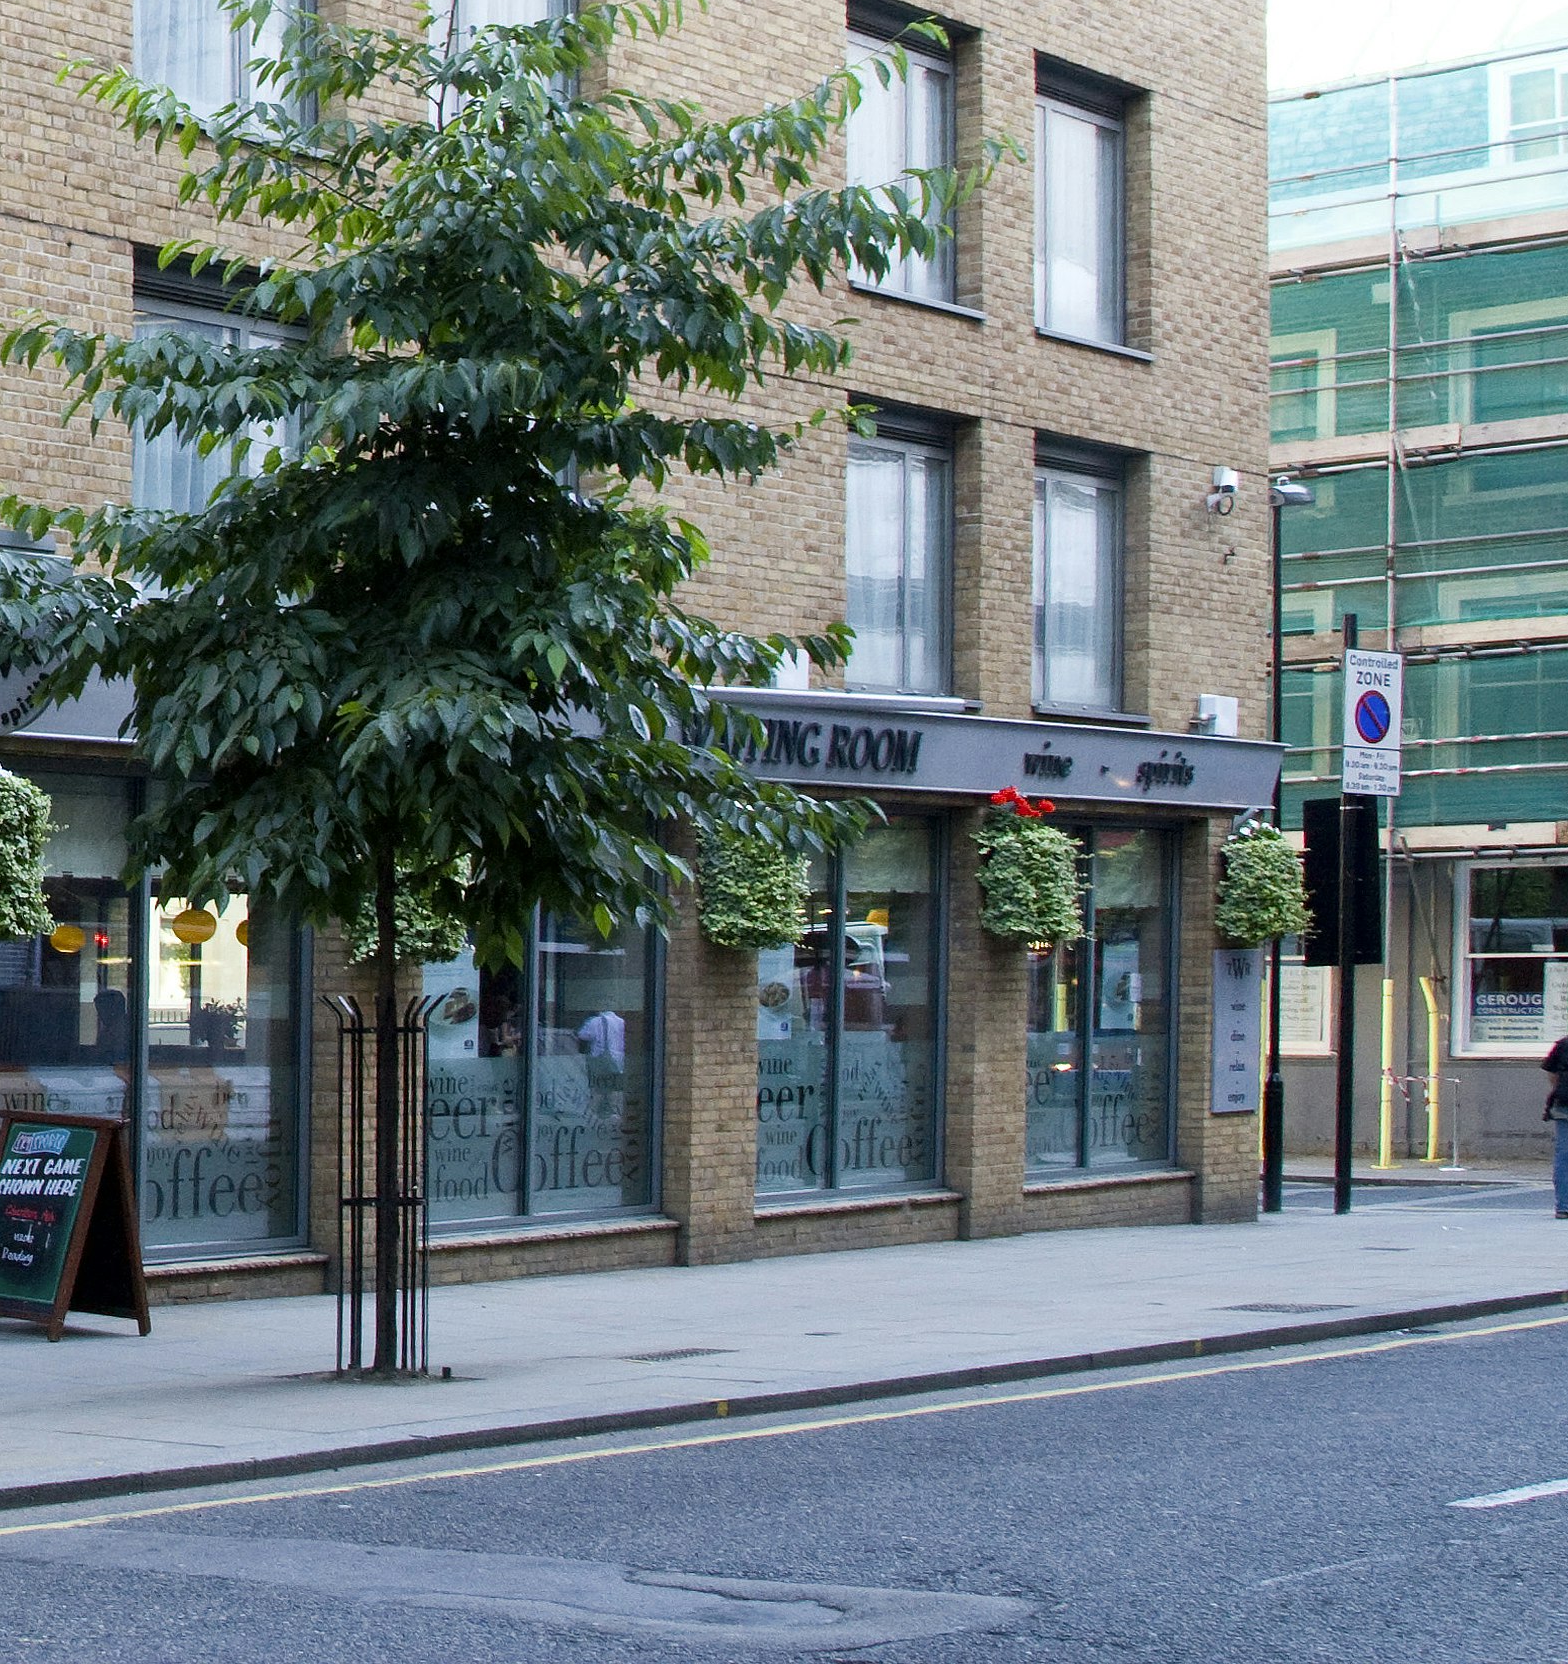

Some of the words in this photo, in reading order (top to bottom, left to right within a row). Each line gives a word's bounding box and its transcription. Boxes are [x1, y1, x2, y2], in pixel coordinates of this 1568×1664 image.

[1349, 654, 1399, 671] Controlled
[1356, 671, 1391, 687] ZONE
[0, 672, 51, 726] spirts
[825, 722, 925, 775] ROOM
[1023, 740, 1074, 779] wine
[1135, 749, 1195, 792] spirits
[2, 1083, 62, 1112] wine
[765, 1124, 797, 1145] wine
[435, 1140, 470, 1162] wine
[1, 1158, 42, 1176] NEXT
[44, 1158, 86, 1176] GAME
[45, 1179, 82, 1197] HERE
[145, 1147, 262, 1224] offee
[434, 1163, 489, 1203] food
